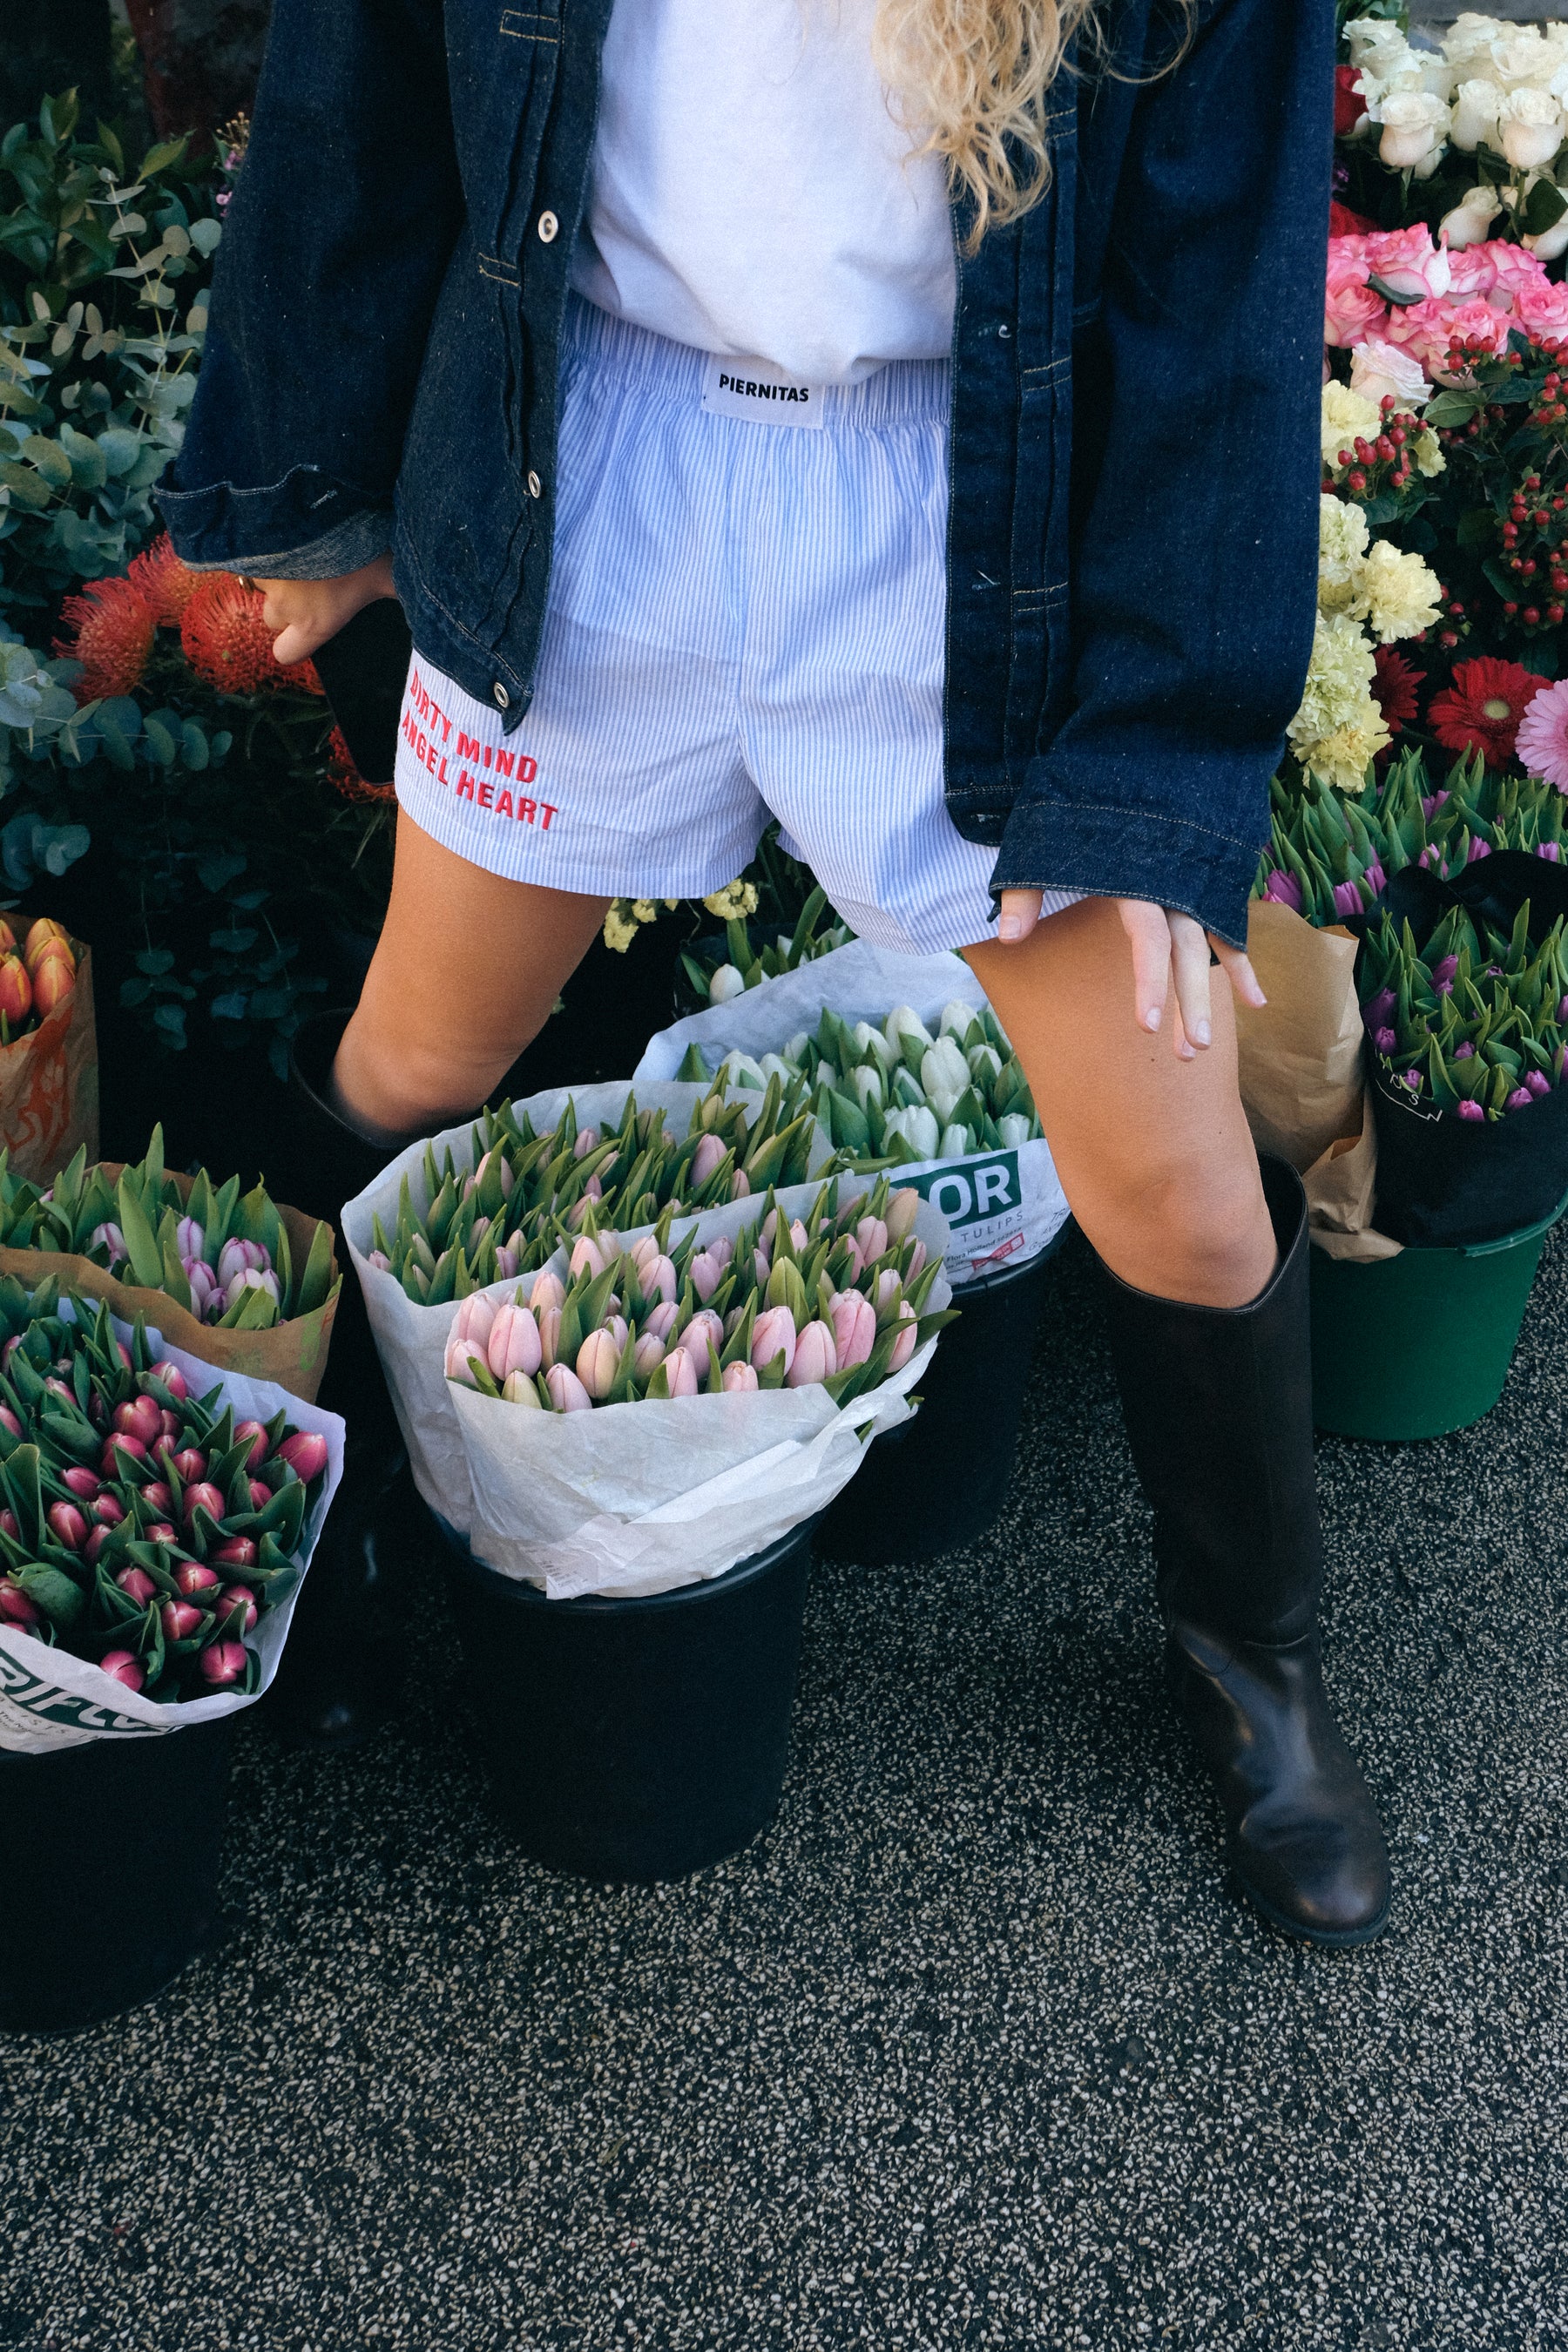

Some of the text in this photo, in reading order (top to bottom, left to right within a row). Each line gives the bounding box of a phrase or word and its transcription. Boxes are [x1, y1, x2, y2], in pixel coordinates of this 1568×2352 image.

[719, 373, 809, 402] PIERNITAS
[409, 666, 538, 784] DIRTY MIND
[402, 708, 558, 831] ANGEL HEART
[961, 1211, 1024, 1244] TULIPS
[946, 1252, 966, 1262] Flora
[967, 1240, 996, 1255] Holland
